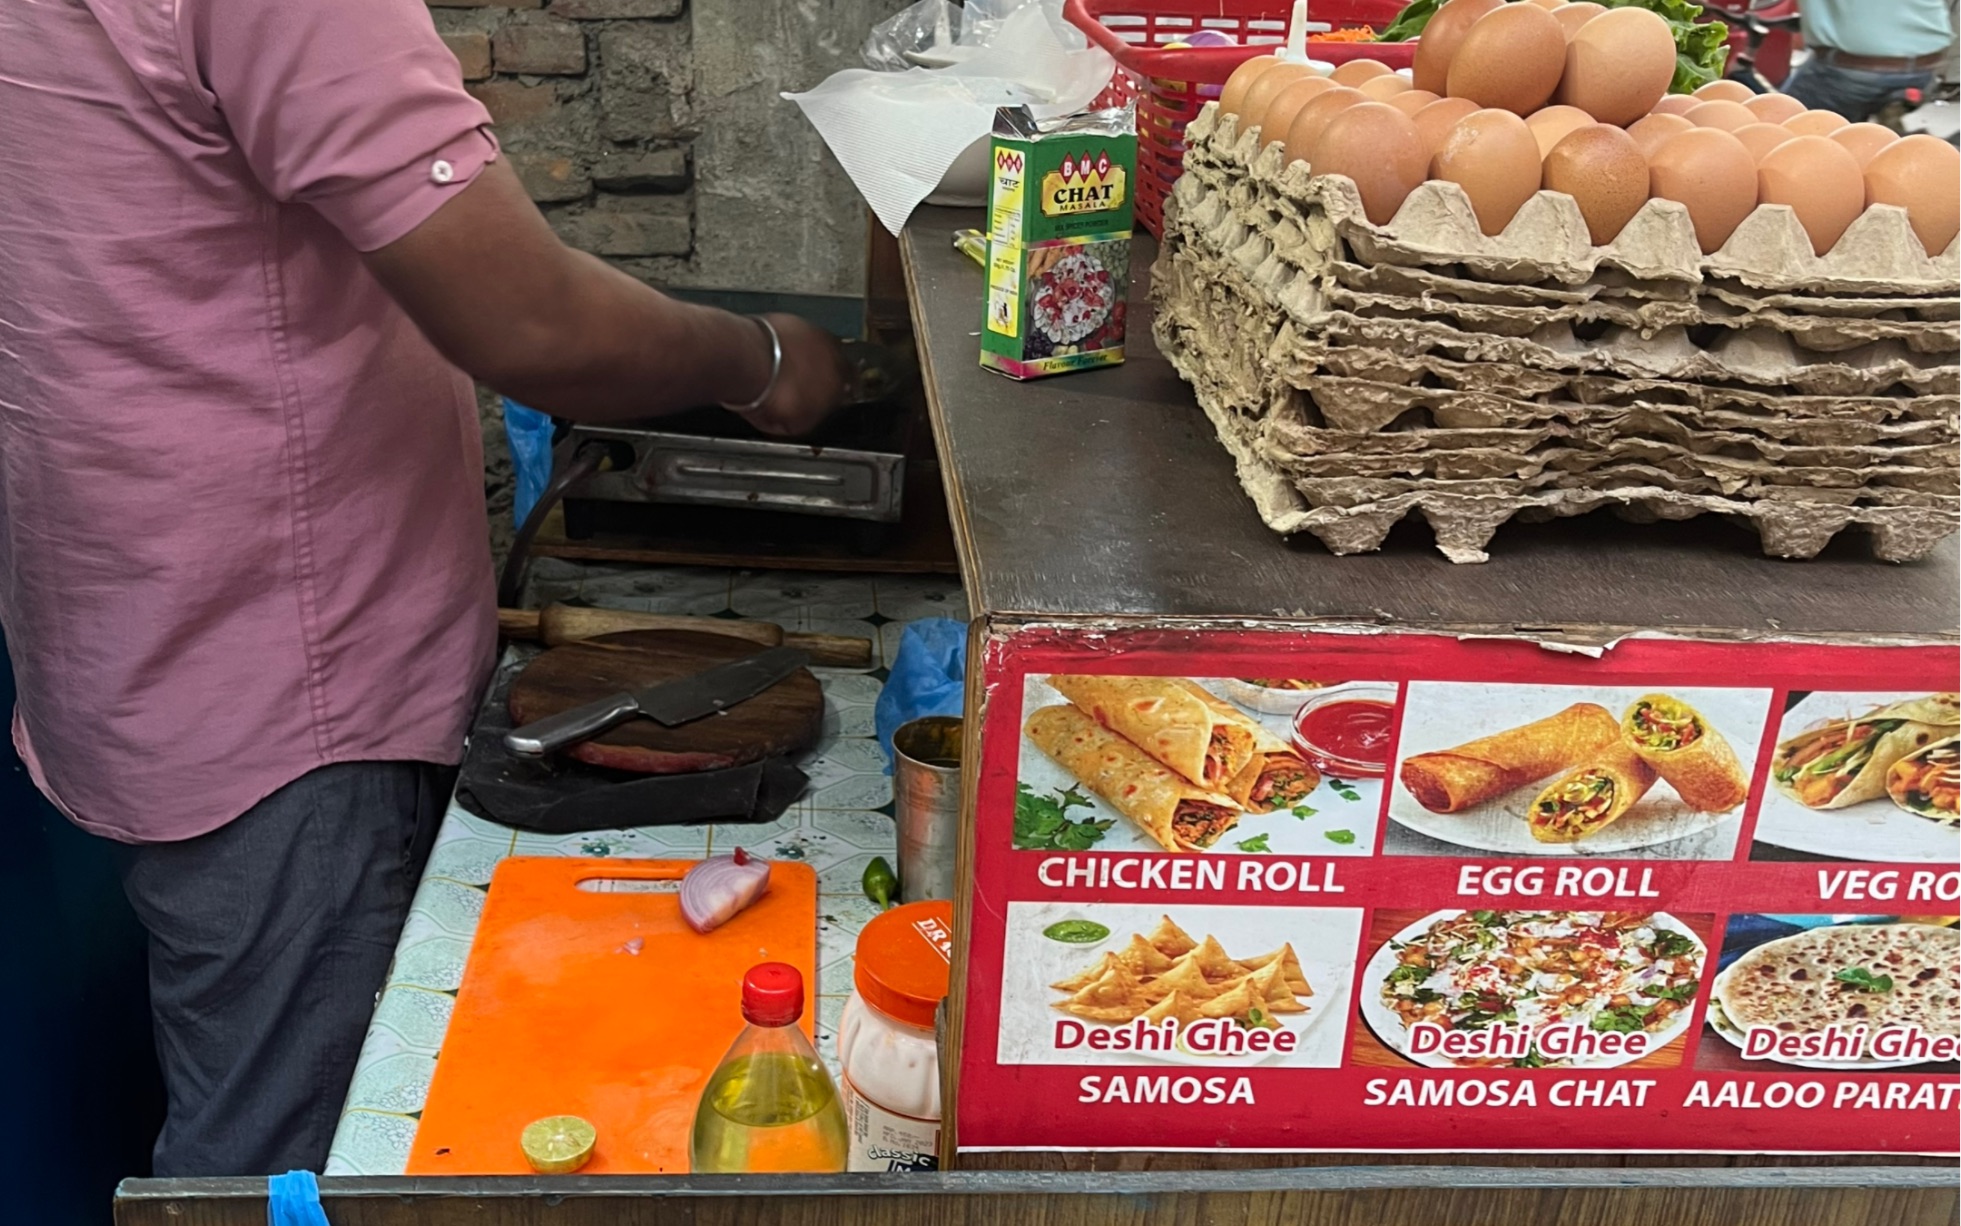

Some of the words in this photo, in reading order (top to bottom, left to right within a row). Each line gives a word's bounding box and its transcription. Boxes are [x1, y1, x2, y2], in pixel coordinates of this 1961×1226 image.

[1062, 158, 1109, 178] BMC
[1053, 184, 1114, 204] CHAT
[1060, 201, 1106, 212] MASALA
[1038, 857, 1226, 891] CHICKEN
[1237, 861, 1345, 893] ROLL
[1457, 865, 1545, 896] EGG
[1554, 866, 1660, 897] ROLL
[1818, 870, 1900, 900] VEG
[1054, 1020, 1175, 1050] Deshi
[1186, 1021, 1296, 1052] Ghee
[1411, 1025, 1530, 1055] Deshi
[1540, 1025, 1647, 1055] Ghee
[1746, 1027, 1866, 1057] Deshi
[1874, 1027, 1960, 1058] Ghe
[1078, 1076, 1256, 1105] SAMOSA
[1363, 1079, 1538, 1107] SAMOSA
[1548, 1079, 1656, 1107] CHAT
[1683, 1080, 1826, 1109] AALOO
[868, 1144, 931, 1167] classic
